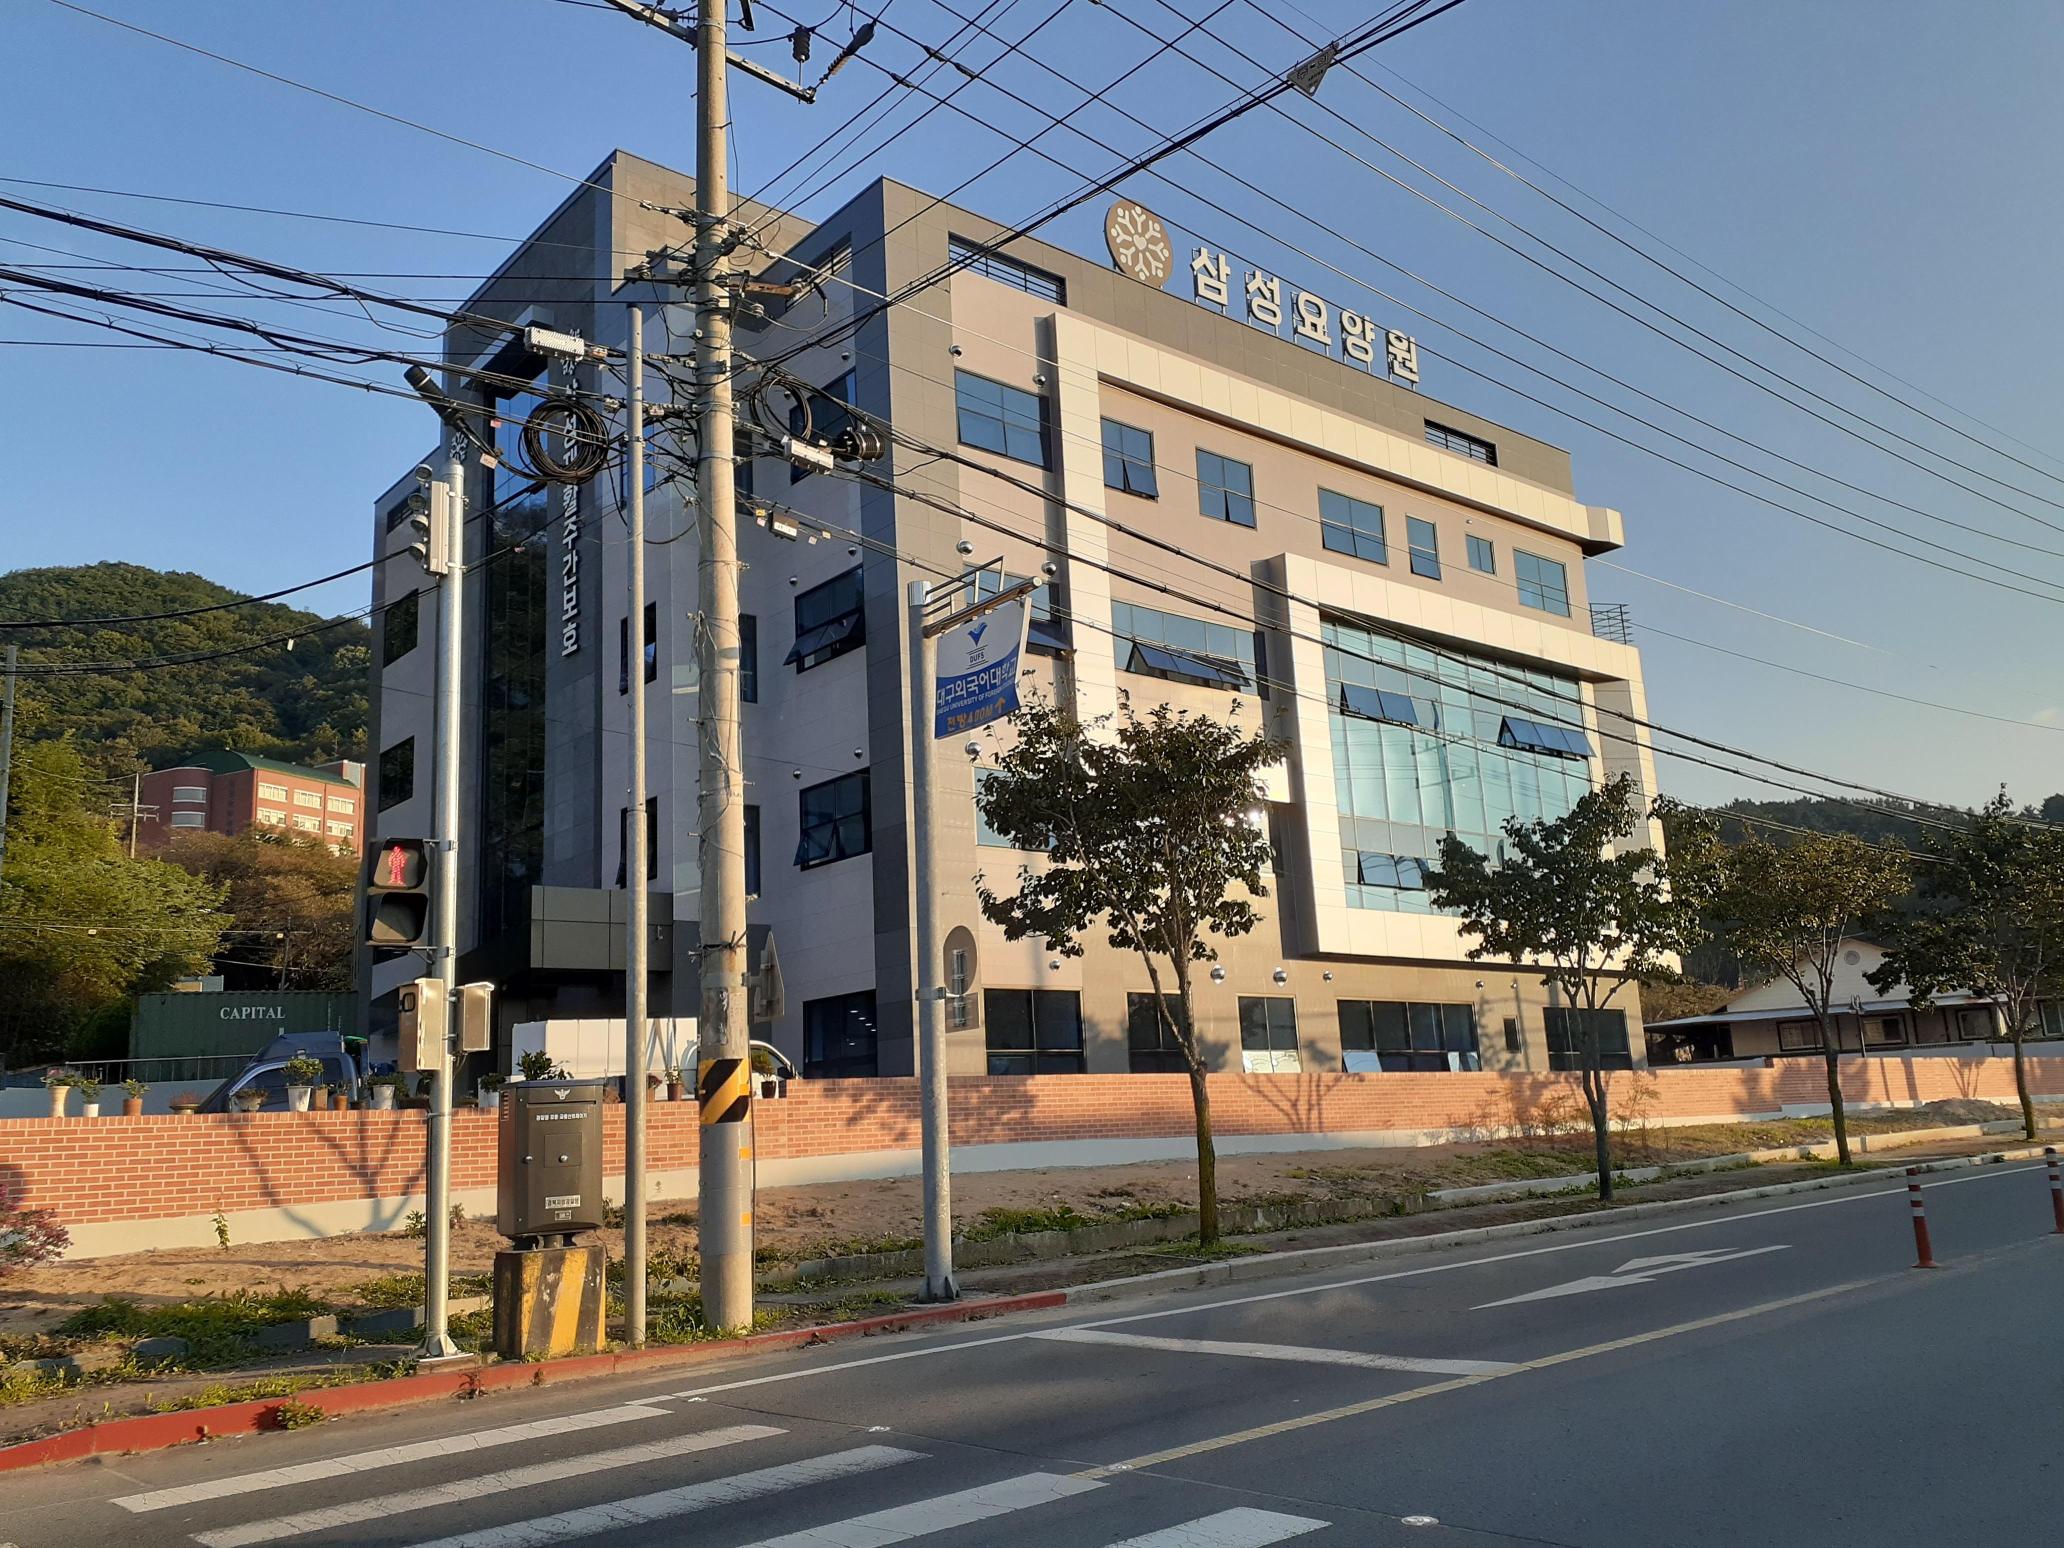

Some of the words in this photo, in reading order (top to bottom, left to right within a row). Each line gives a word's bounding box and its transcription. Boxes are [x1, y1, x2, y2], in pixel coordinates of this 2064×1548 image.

[1191, 246, 1420, 383] 삼성요양원
[969, 651, 985, 664] DUFS
[936, 656, 1017, 707] 대구외국어대학교
[950, 696, 979, 711] UNIVERSITY
[220, 1006, 286, 1020] CAPITAL
